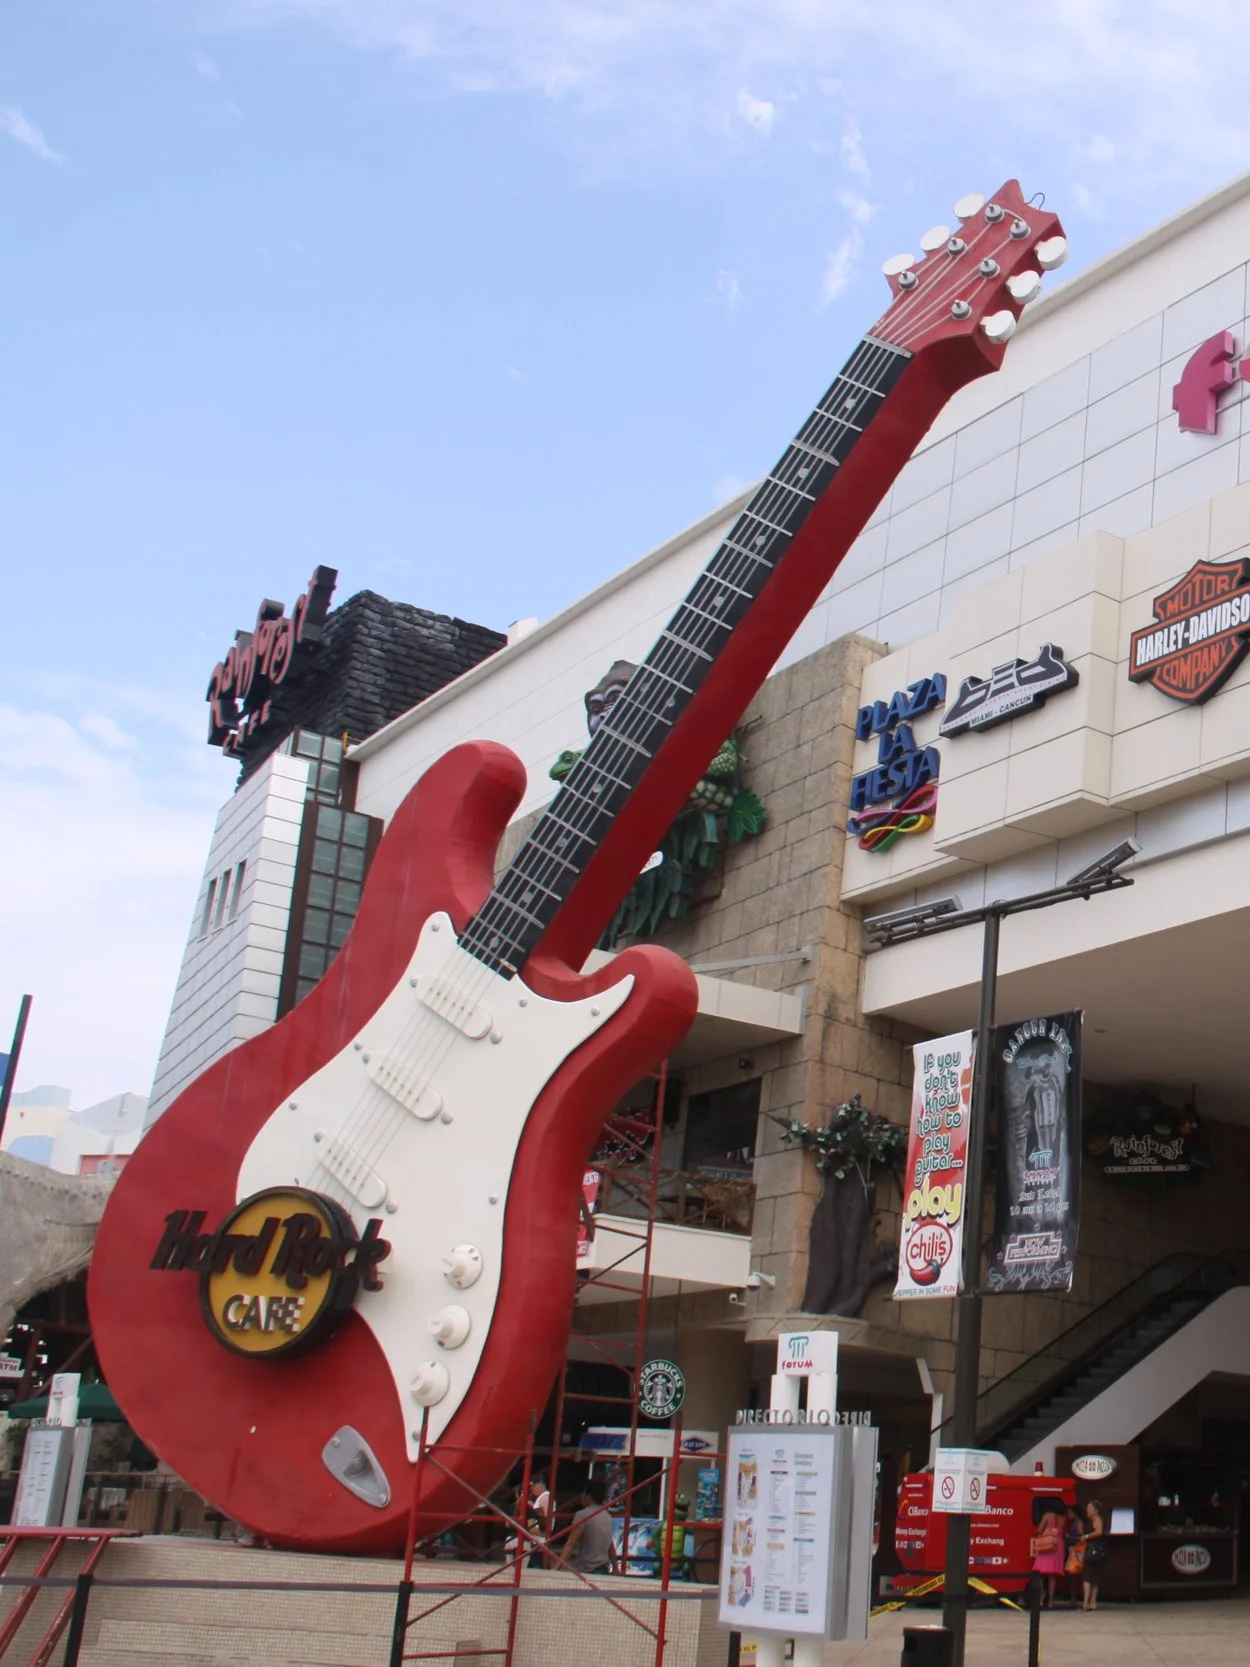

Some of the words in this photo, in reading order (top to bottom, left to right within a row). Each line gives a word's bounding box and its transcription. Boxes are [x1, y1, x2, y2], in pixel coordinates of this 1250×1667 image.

[1166, 573, 1231, 617] MOTOR
[1163, 638, 1228, 689] COMPANY
[856, 673, 947, 741] PLAZA
[970, 711, 993, 725] MIAMI
[999, 693, 1032, 713] CANCUN
[878, 723, 917, 765] LA
[851, 746, 940, 811] FIESTA
[924, 1052, 935, 1073] If
[937, 1051, 961, 1075] you
[924, 1070, 959, 1094] don't
[925, 1091, 960, 1114] know
[916, 1115, 941, 1137] how
[945, 1111, 962, 1128] to
[923, 1131, 950, 1157] play
[906, 1177, 962, 1231] play
[149, 1210, 282, 1275] Hard
[270, 1212, 392, 1292] Rock
[910, 1232, 947, 1263] chili's
[925, 1286, 941, 1294] SOME
[943, 1285, 955, 1293] FUN
[222, 1294, 305, 1332] CAFE
[640, 1399, 677, 1416] COFFEE
